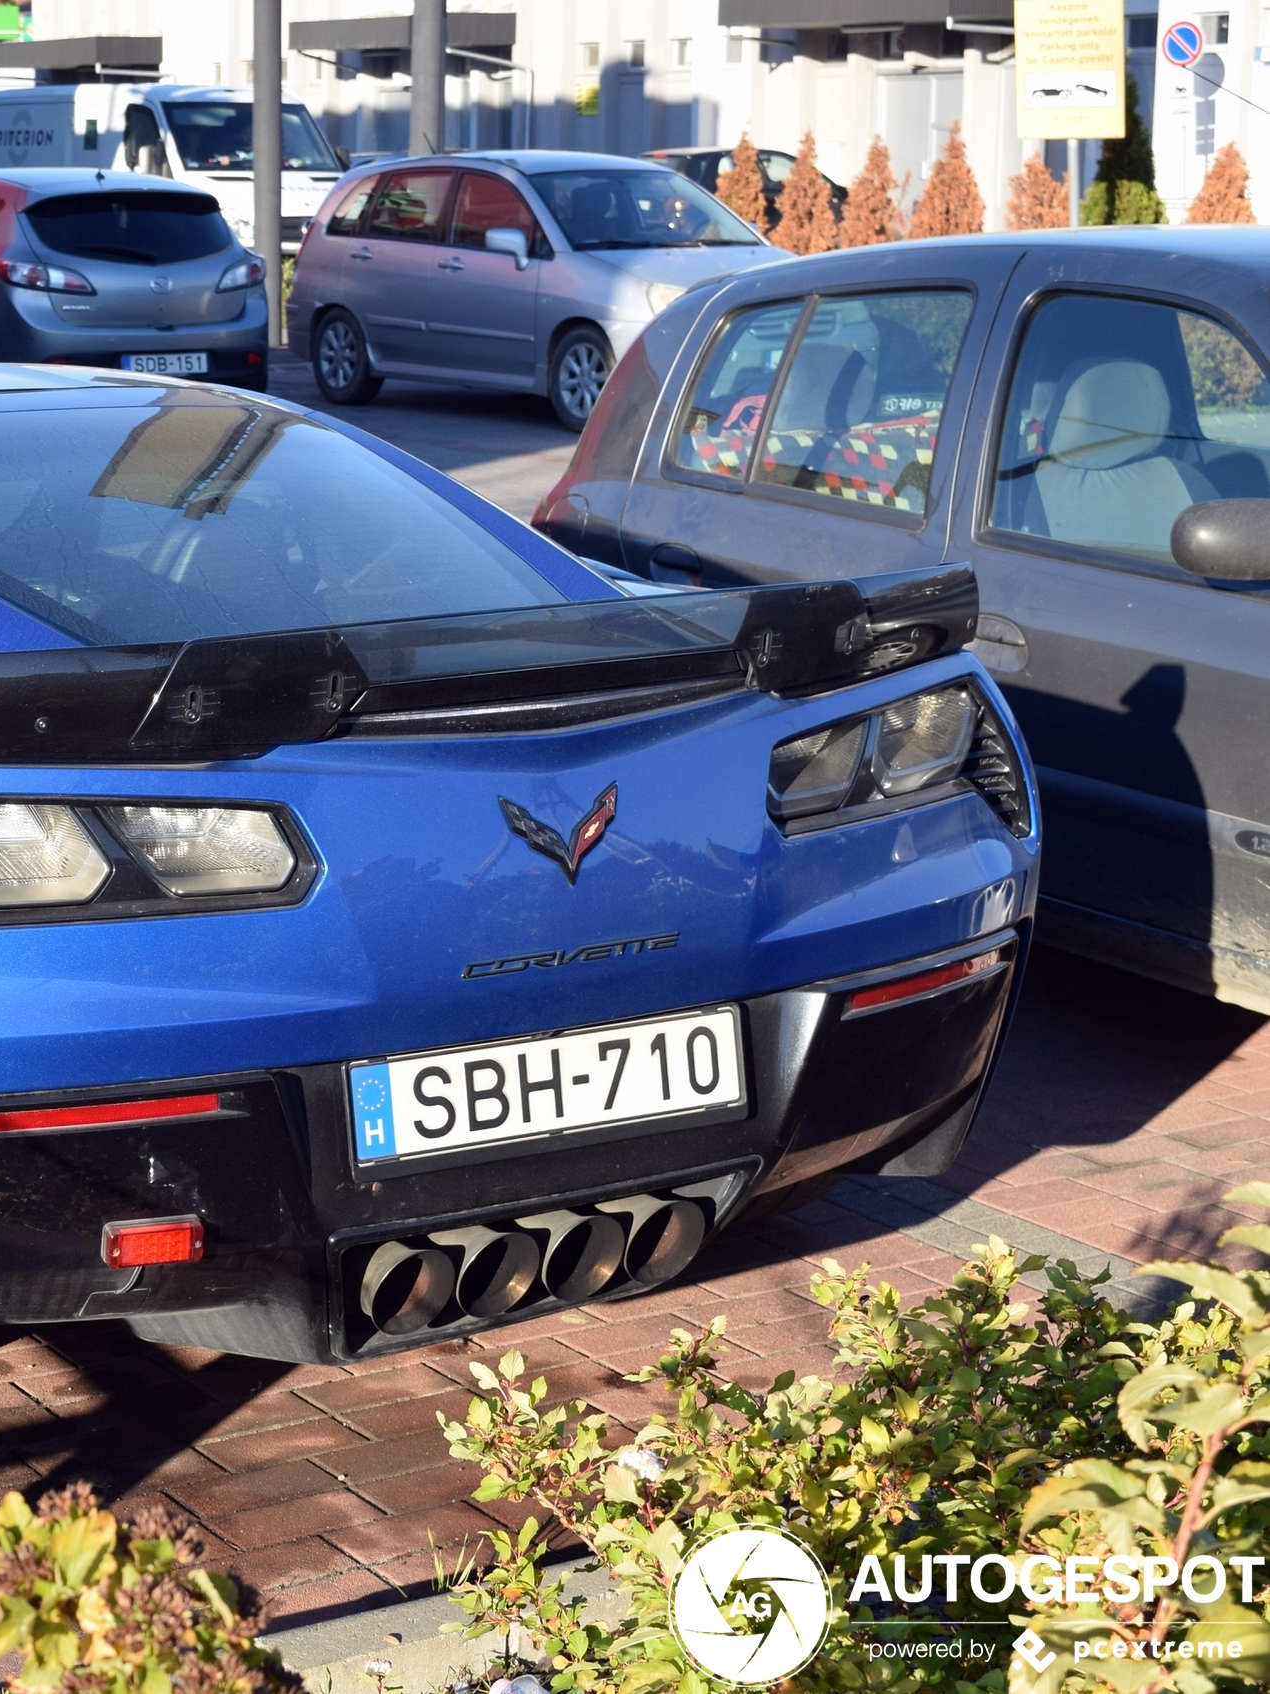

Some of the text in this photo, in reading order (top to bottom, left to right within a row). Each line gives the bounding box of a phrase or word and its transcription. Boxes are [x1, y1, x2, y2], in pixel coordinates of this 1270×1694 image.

[1039, 41, 1100, 52] Parking only
[1042, 55, 1075, 65] Casino
[134, 356, 203, 373] SDB-151
[460, 931, 680, 980] CORVETTE
[364, 1025, 721, 1147] H SBH-710
